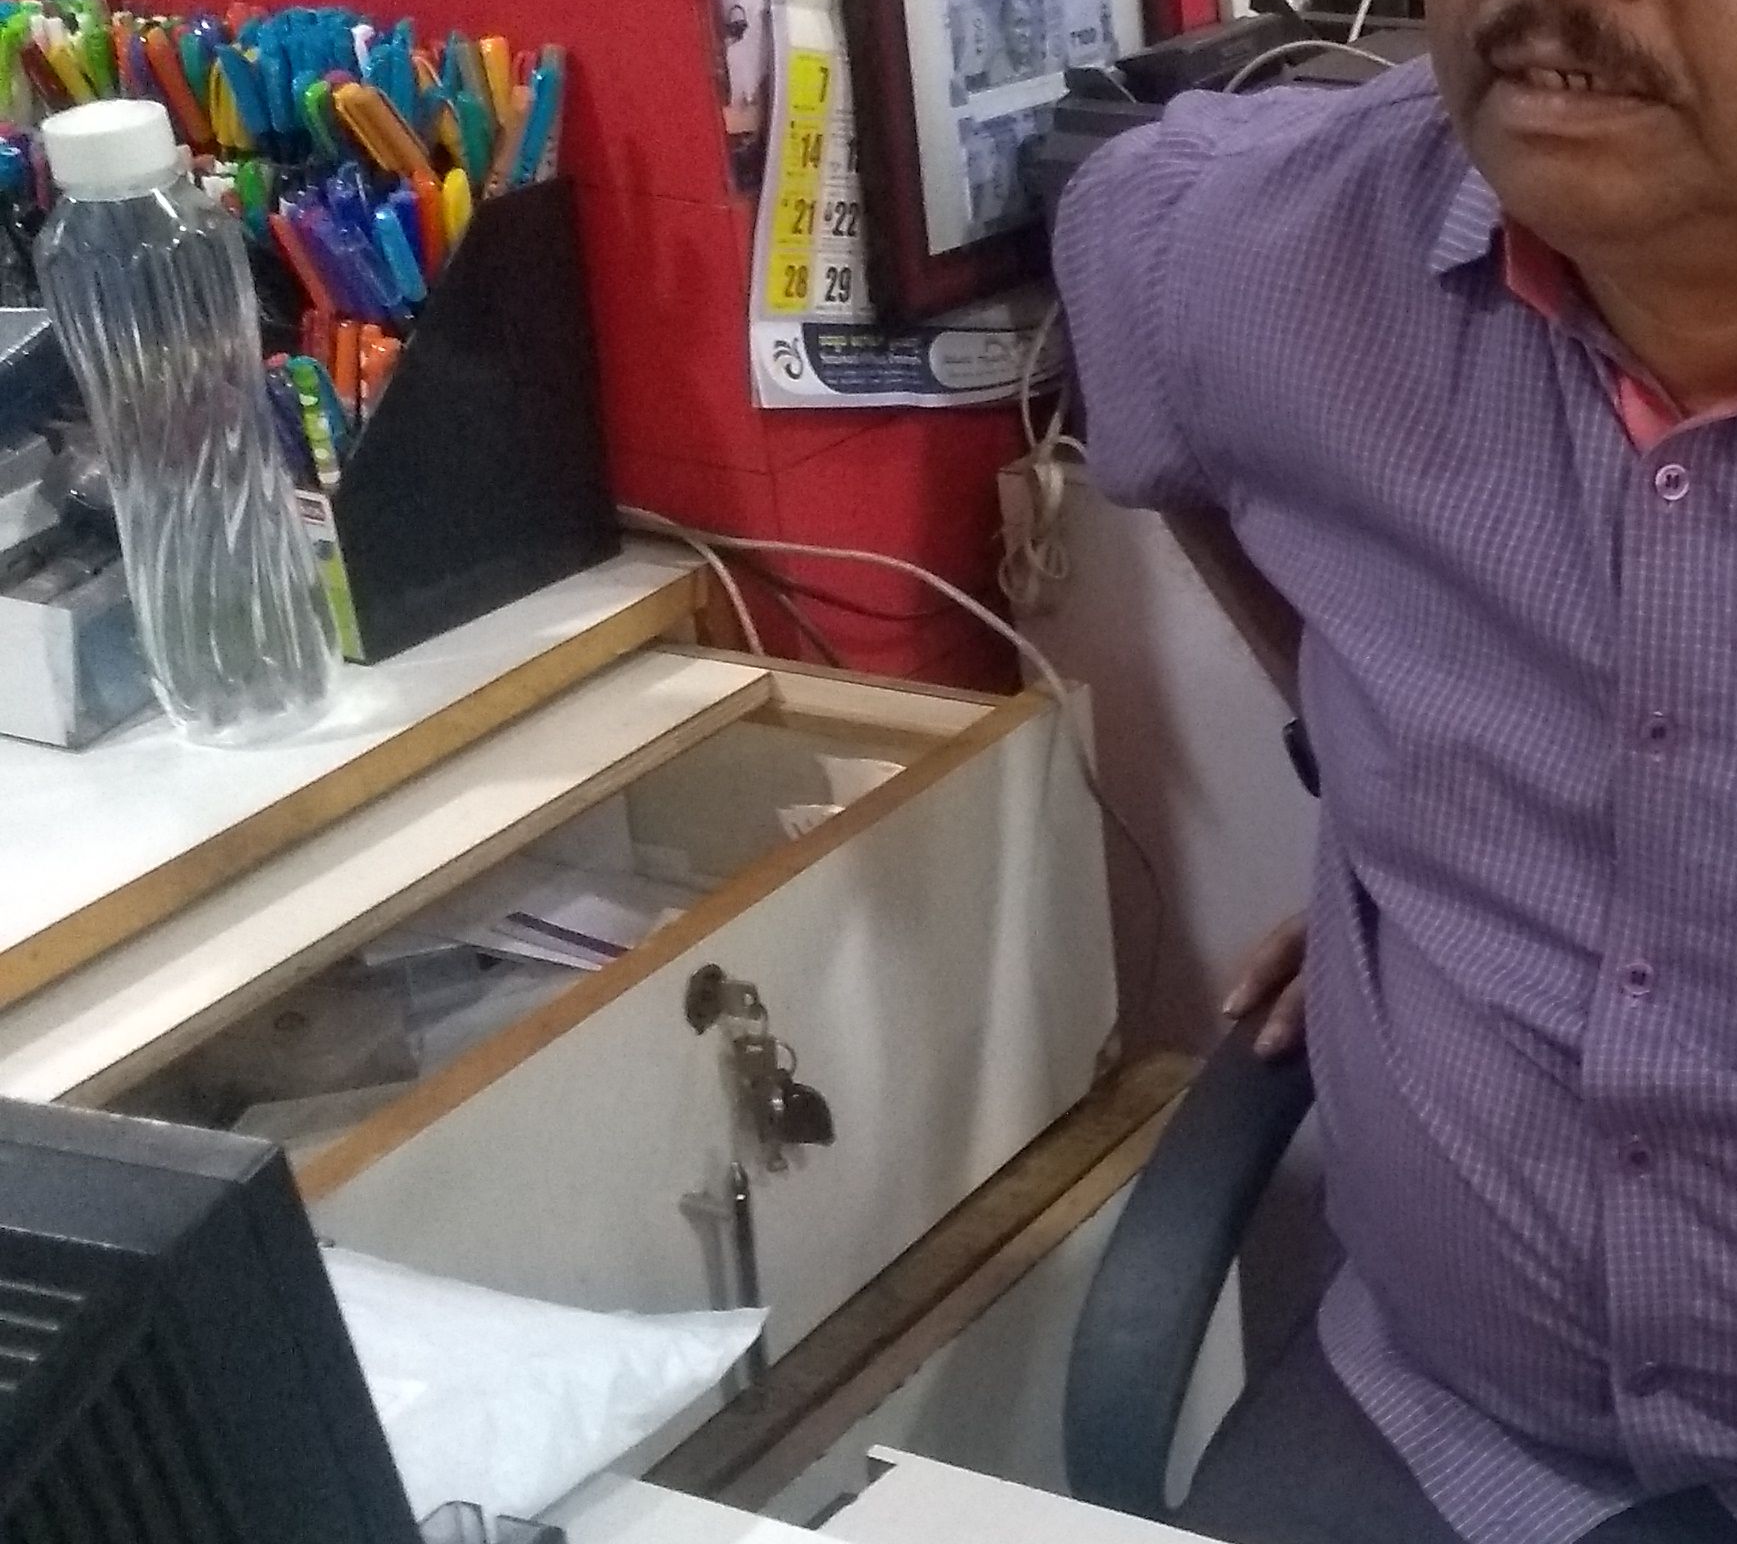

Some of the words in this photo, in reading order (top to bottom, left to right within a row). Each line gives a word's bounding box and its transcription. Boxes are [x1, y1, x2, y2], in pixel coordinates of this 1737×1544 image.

[801, 132, 823, 169] 14
[791, 198, 817, 235] 21
[832, 200, 860, 237] 22
[783, 265, 809, 299] 28
[824, 266, 853, 304] 29
